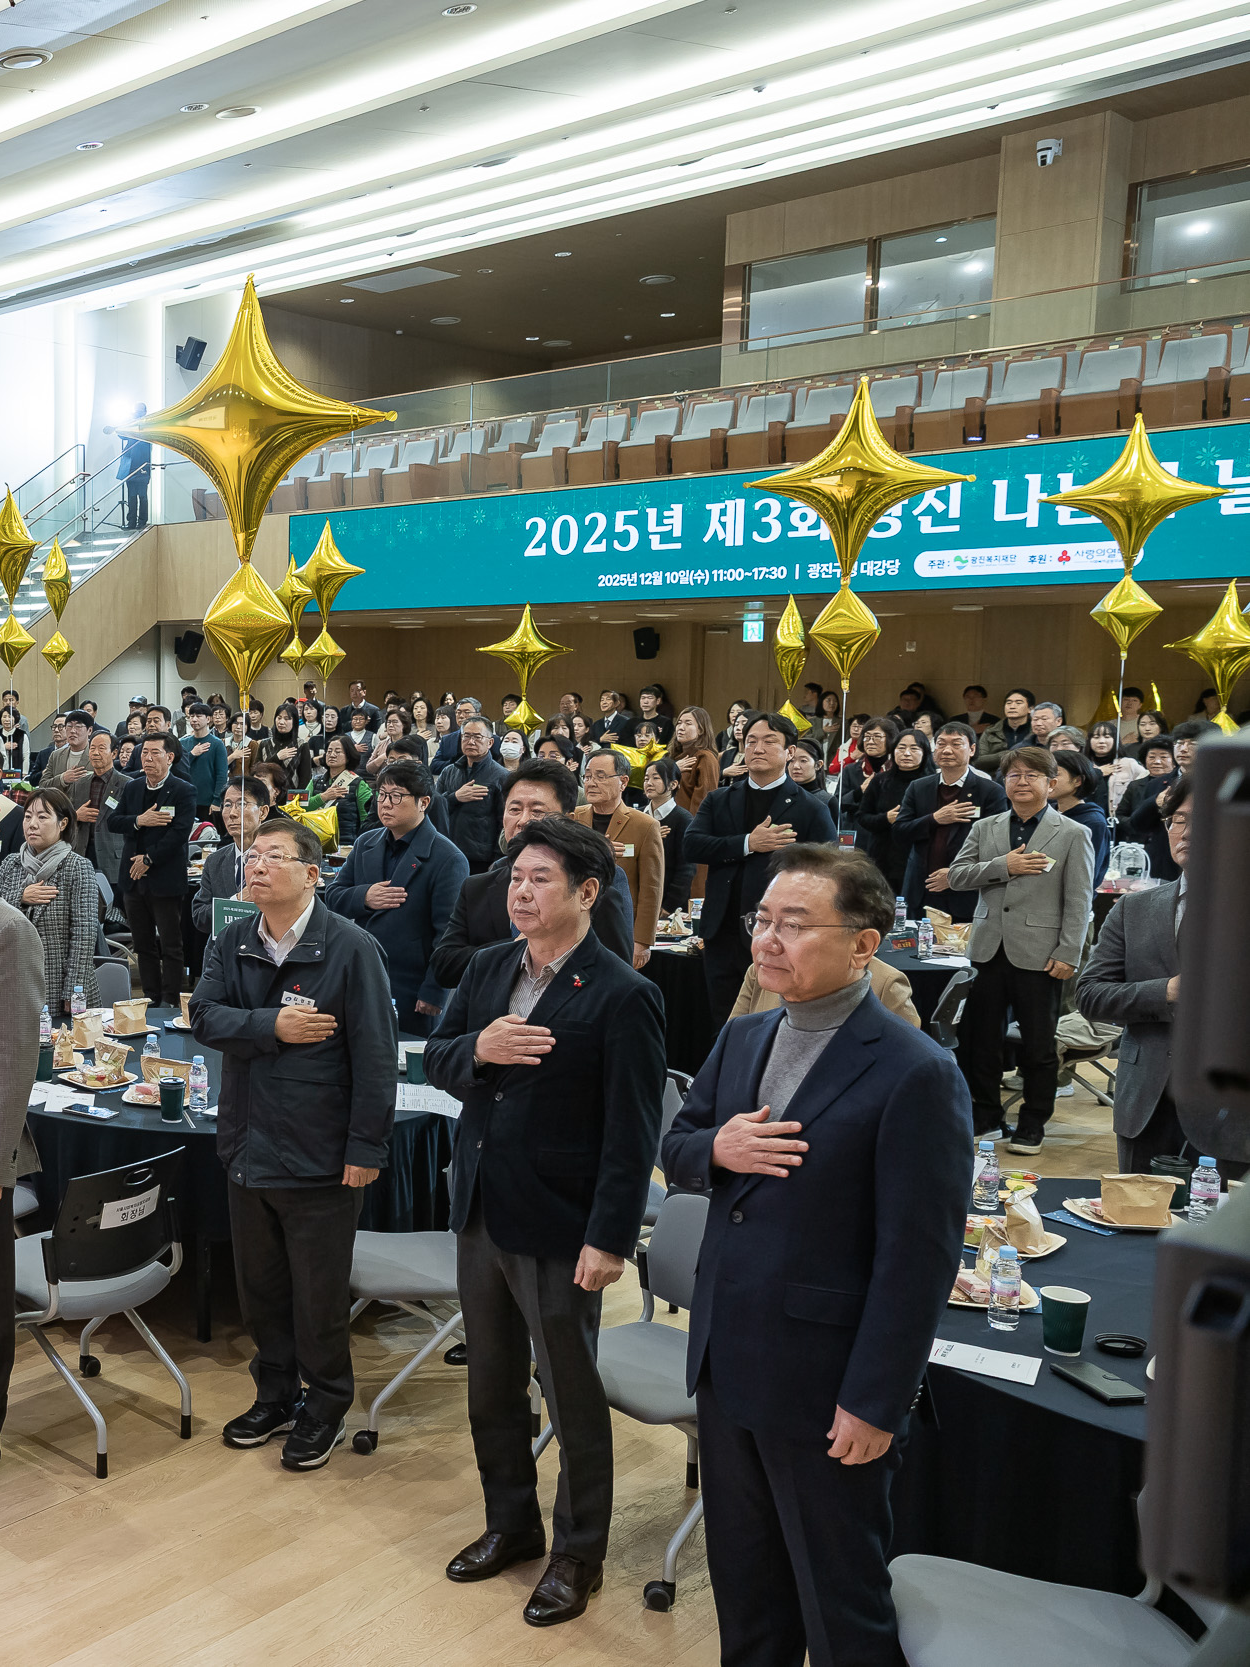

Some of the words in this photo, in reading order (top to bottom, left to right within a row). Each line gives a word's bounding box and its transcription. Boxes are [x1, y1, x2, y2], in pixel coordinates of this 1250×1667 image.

[524, 503, 683, 557] 2025년
[597, 572, 638, 588] 2025년
[639, 570, 664, 586] 12월
[664, 569, 710, 586] 10일(수)
[711, 565, 788, 582] 11:00~17:30
[860, 558, 902, 577] 대강당
[120, 1204, 146, 1222] 회장님
